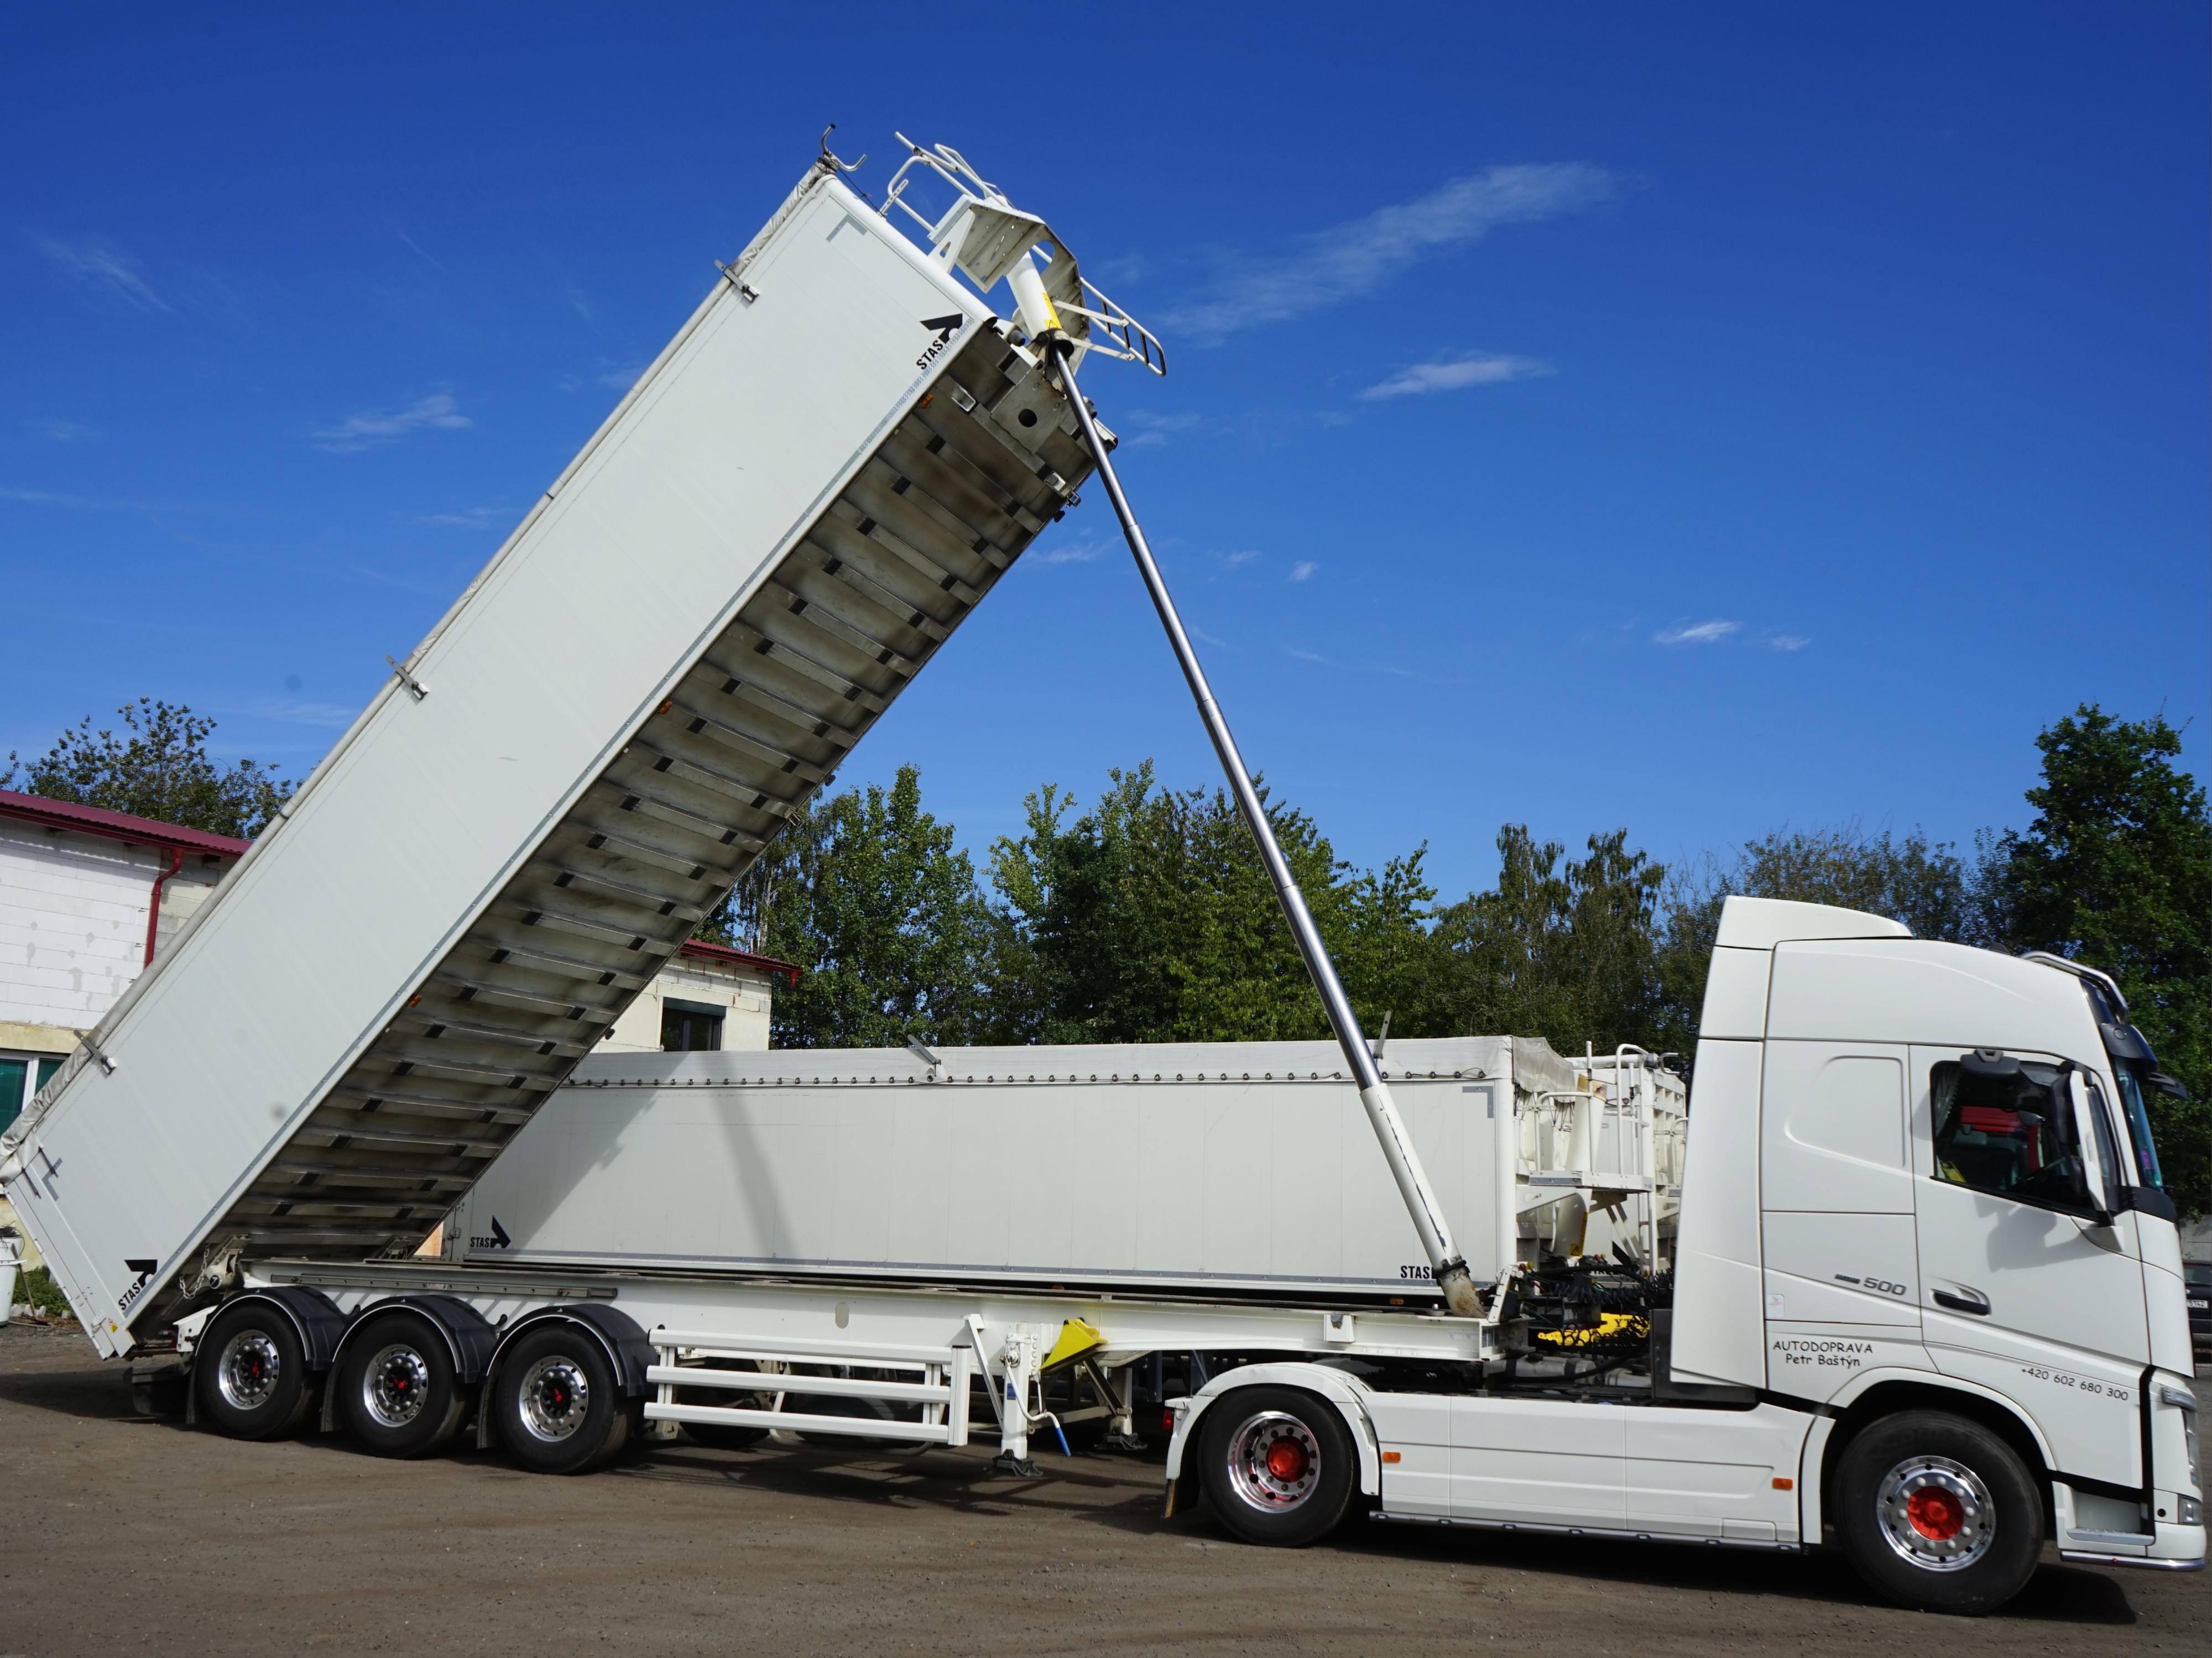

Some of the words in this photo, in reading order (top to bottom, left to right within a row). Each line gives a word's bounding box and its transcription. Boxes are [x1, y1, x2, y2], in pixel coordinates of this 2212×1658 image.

[916, 339, 943, 370] STAS
[469, 1237, 489, 1248] STAS
[1400, 1265, 1430, 1279] STAS
[1864, 1277, 1907, 1295] 500
[118, 1282, 140, 1310] STAS
[1773, 1341, 1873, 1353] AUTODOPRAVA
[1786, 1353, 1812, 1364] Petr
[1818, 1354, 1860, 1369] Baštýn
[2021, 1368, 2049, 1380] +420
[2054, 1374, 2075, 1387] 602
[2080, 1382, 2102, 1394] 680
[2106, 1388, 2128, 1400] 300
